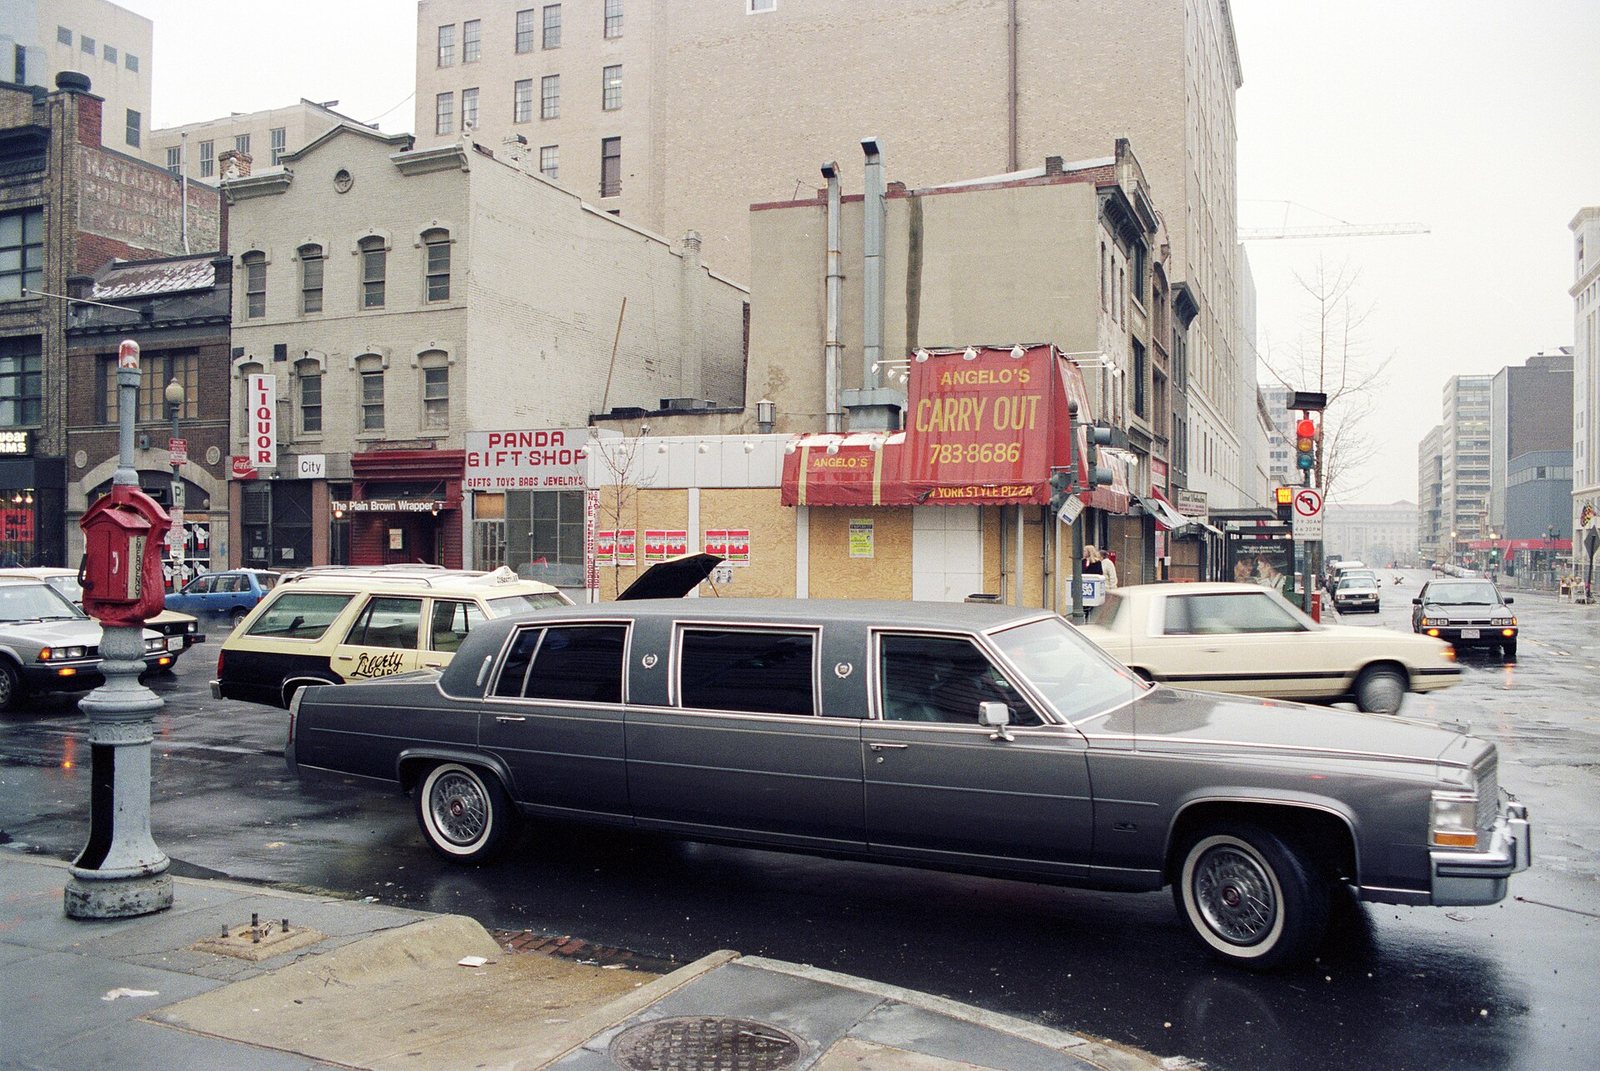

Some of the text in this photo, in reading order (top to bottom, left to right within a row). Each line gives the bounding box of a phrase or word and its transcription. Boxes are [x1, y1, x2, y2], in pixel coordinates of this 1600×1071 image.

[941, 368, 1030, 385] ANGELO'S
[257, 378, 271, 462] LIQUOR
[916, 395, 1042, 432] CARRY OUT
[489, 431, 564, 448] PANDA
[468, 450, 586, 467] GIFT SHOP
[930, 443, 1021, 464] 783-8686
[302, 461, 320, 474] City
[814, 458, 868, 468] ANGELO'S
[468, 478, 491, 487] GIFTS
[496, 478, 515, 487] TOYS
[518, 477, 538, 486] BAGS
[938, 487, 963, 498] YORK
[966, 486, 999, 498] STYLE
[1001, 486, 1032, 497] PIZZA
[332, 500, 434, 512] The Plain Brown Wrapper
[350, 652, 403, 678] Liberty
